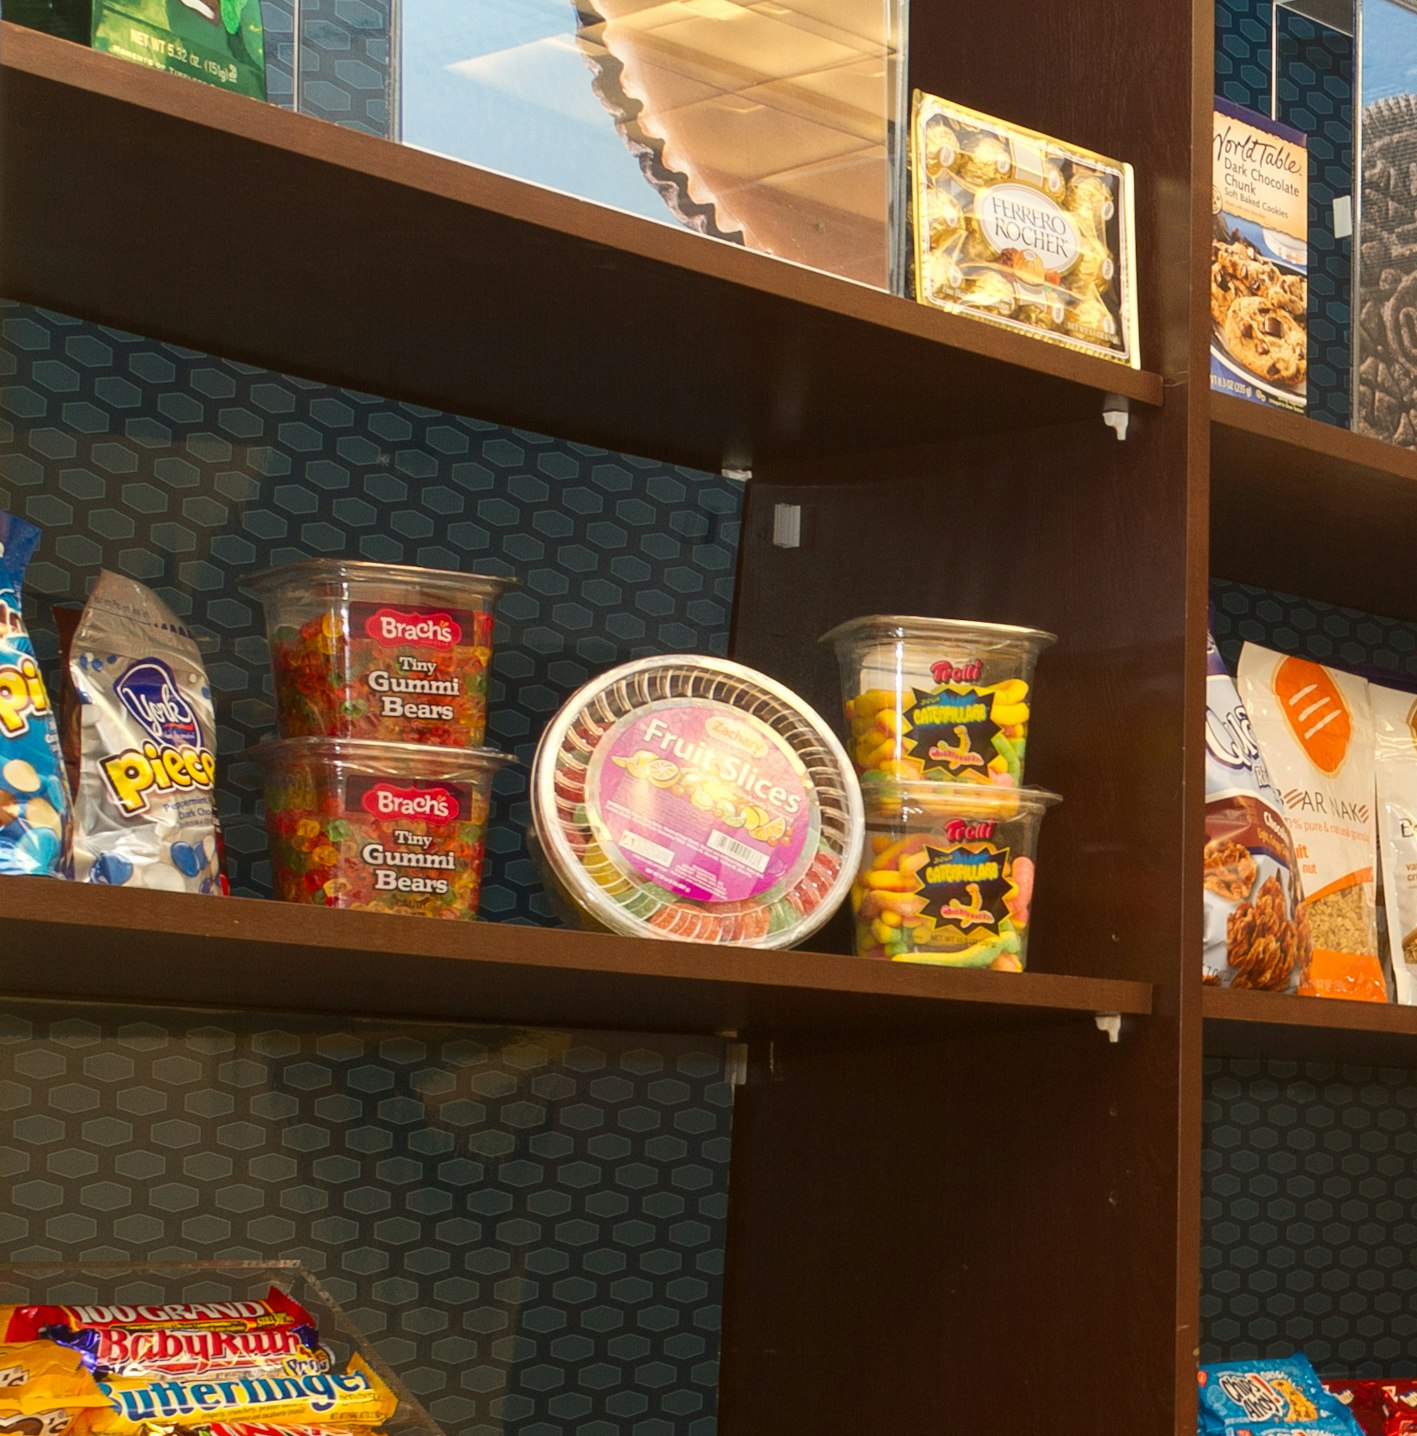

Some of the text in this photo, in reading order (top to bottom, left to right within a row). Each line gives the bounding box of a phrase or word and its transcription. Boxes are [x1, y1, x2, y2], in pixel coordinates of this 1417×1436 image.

[130, 29, 149, 47] NET
[152, 39, 166, 54] WT
[1224, 156, 1300, 198] Dark Chocolate
[1224, 174, 1256, 197] Chunk
[992, 196, 1067, 235] FERRERO
[1224, 187, 1289, 220] Soft Baked Cookies
[993, 217, 1069, 259] ROCHER
[380, 616, 453, 644] Brach's
[399, 656, 437, 675] Tiny
[930, 660, 982, 684] Trolli
[367, 670, 461, 697] Gummi
[382, 697, 454, 721] Bears
[641, 717, 802, 816] Fruit Slices
[376, 789, 449, 818] Brach's
[394, 830, 432, 849] Tiny
[945, 819, 995, 843] Trolli
[362, 845, 456, 871] Gummi
[375, 870, 448, 894] Bears
[73, 1301, 264, 1324] 100 GRAND
